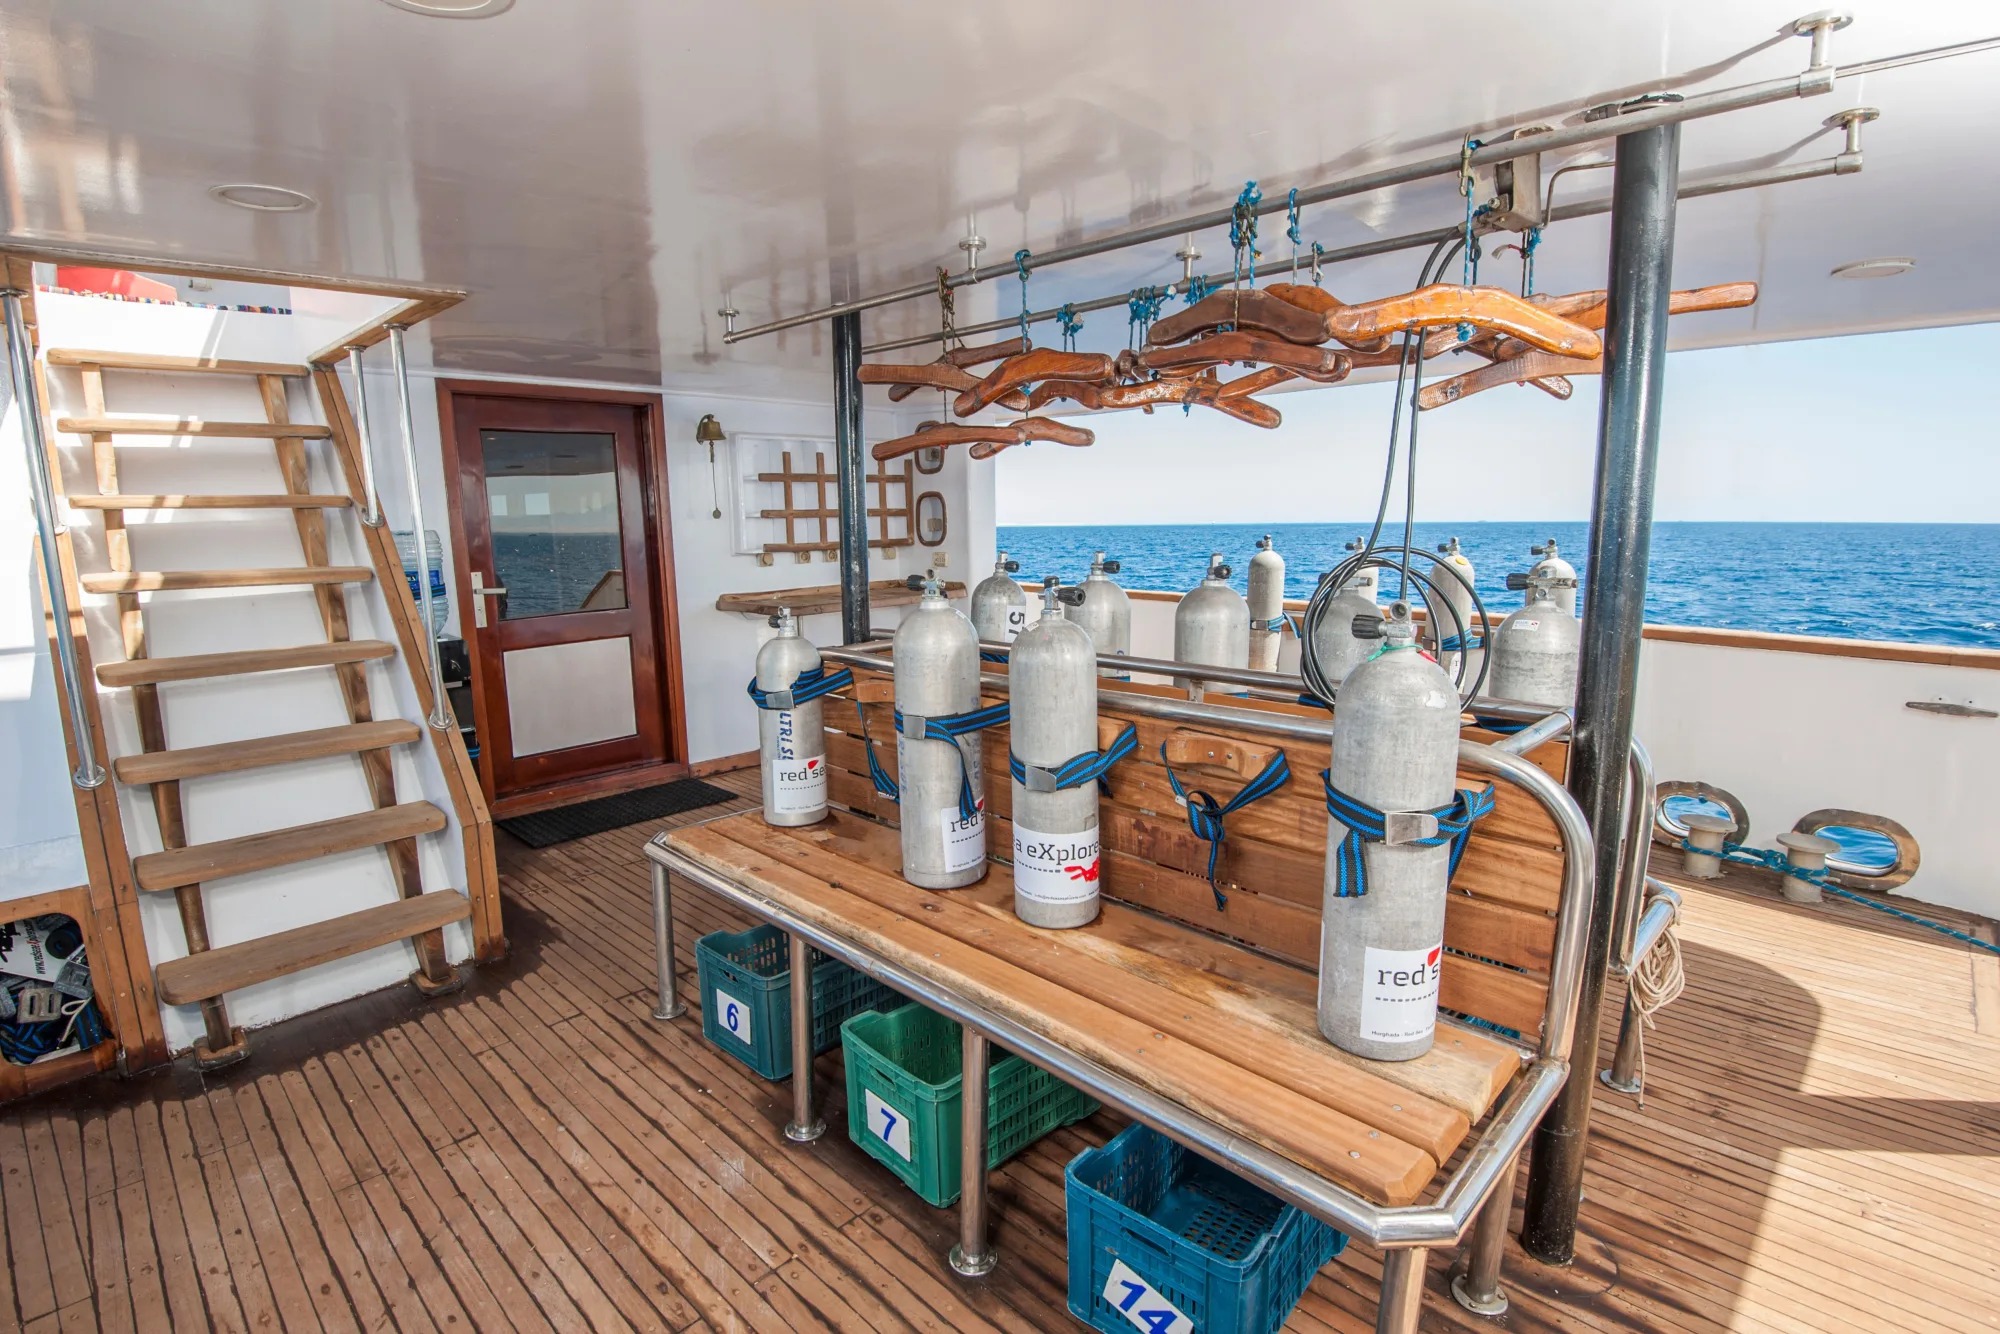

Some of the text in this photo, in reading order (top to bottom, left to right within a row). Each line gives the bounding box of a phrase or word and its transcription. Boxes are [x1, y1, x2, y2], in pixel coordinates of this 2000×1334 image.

[779, 711, 793, 743] LTRI
[780, 767, 808, 782] red
[950, 812, 979, 833] red
[1014, 838, 1023, 854] a
[1377, 963, 1426, 987] red
[726, 1003, 739, 1032] 6
[880, 1107, 897, 1142] 7
[1118, 1279, 1178, 1334] 14
